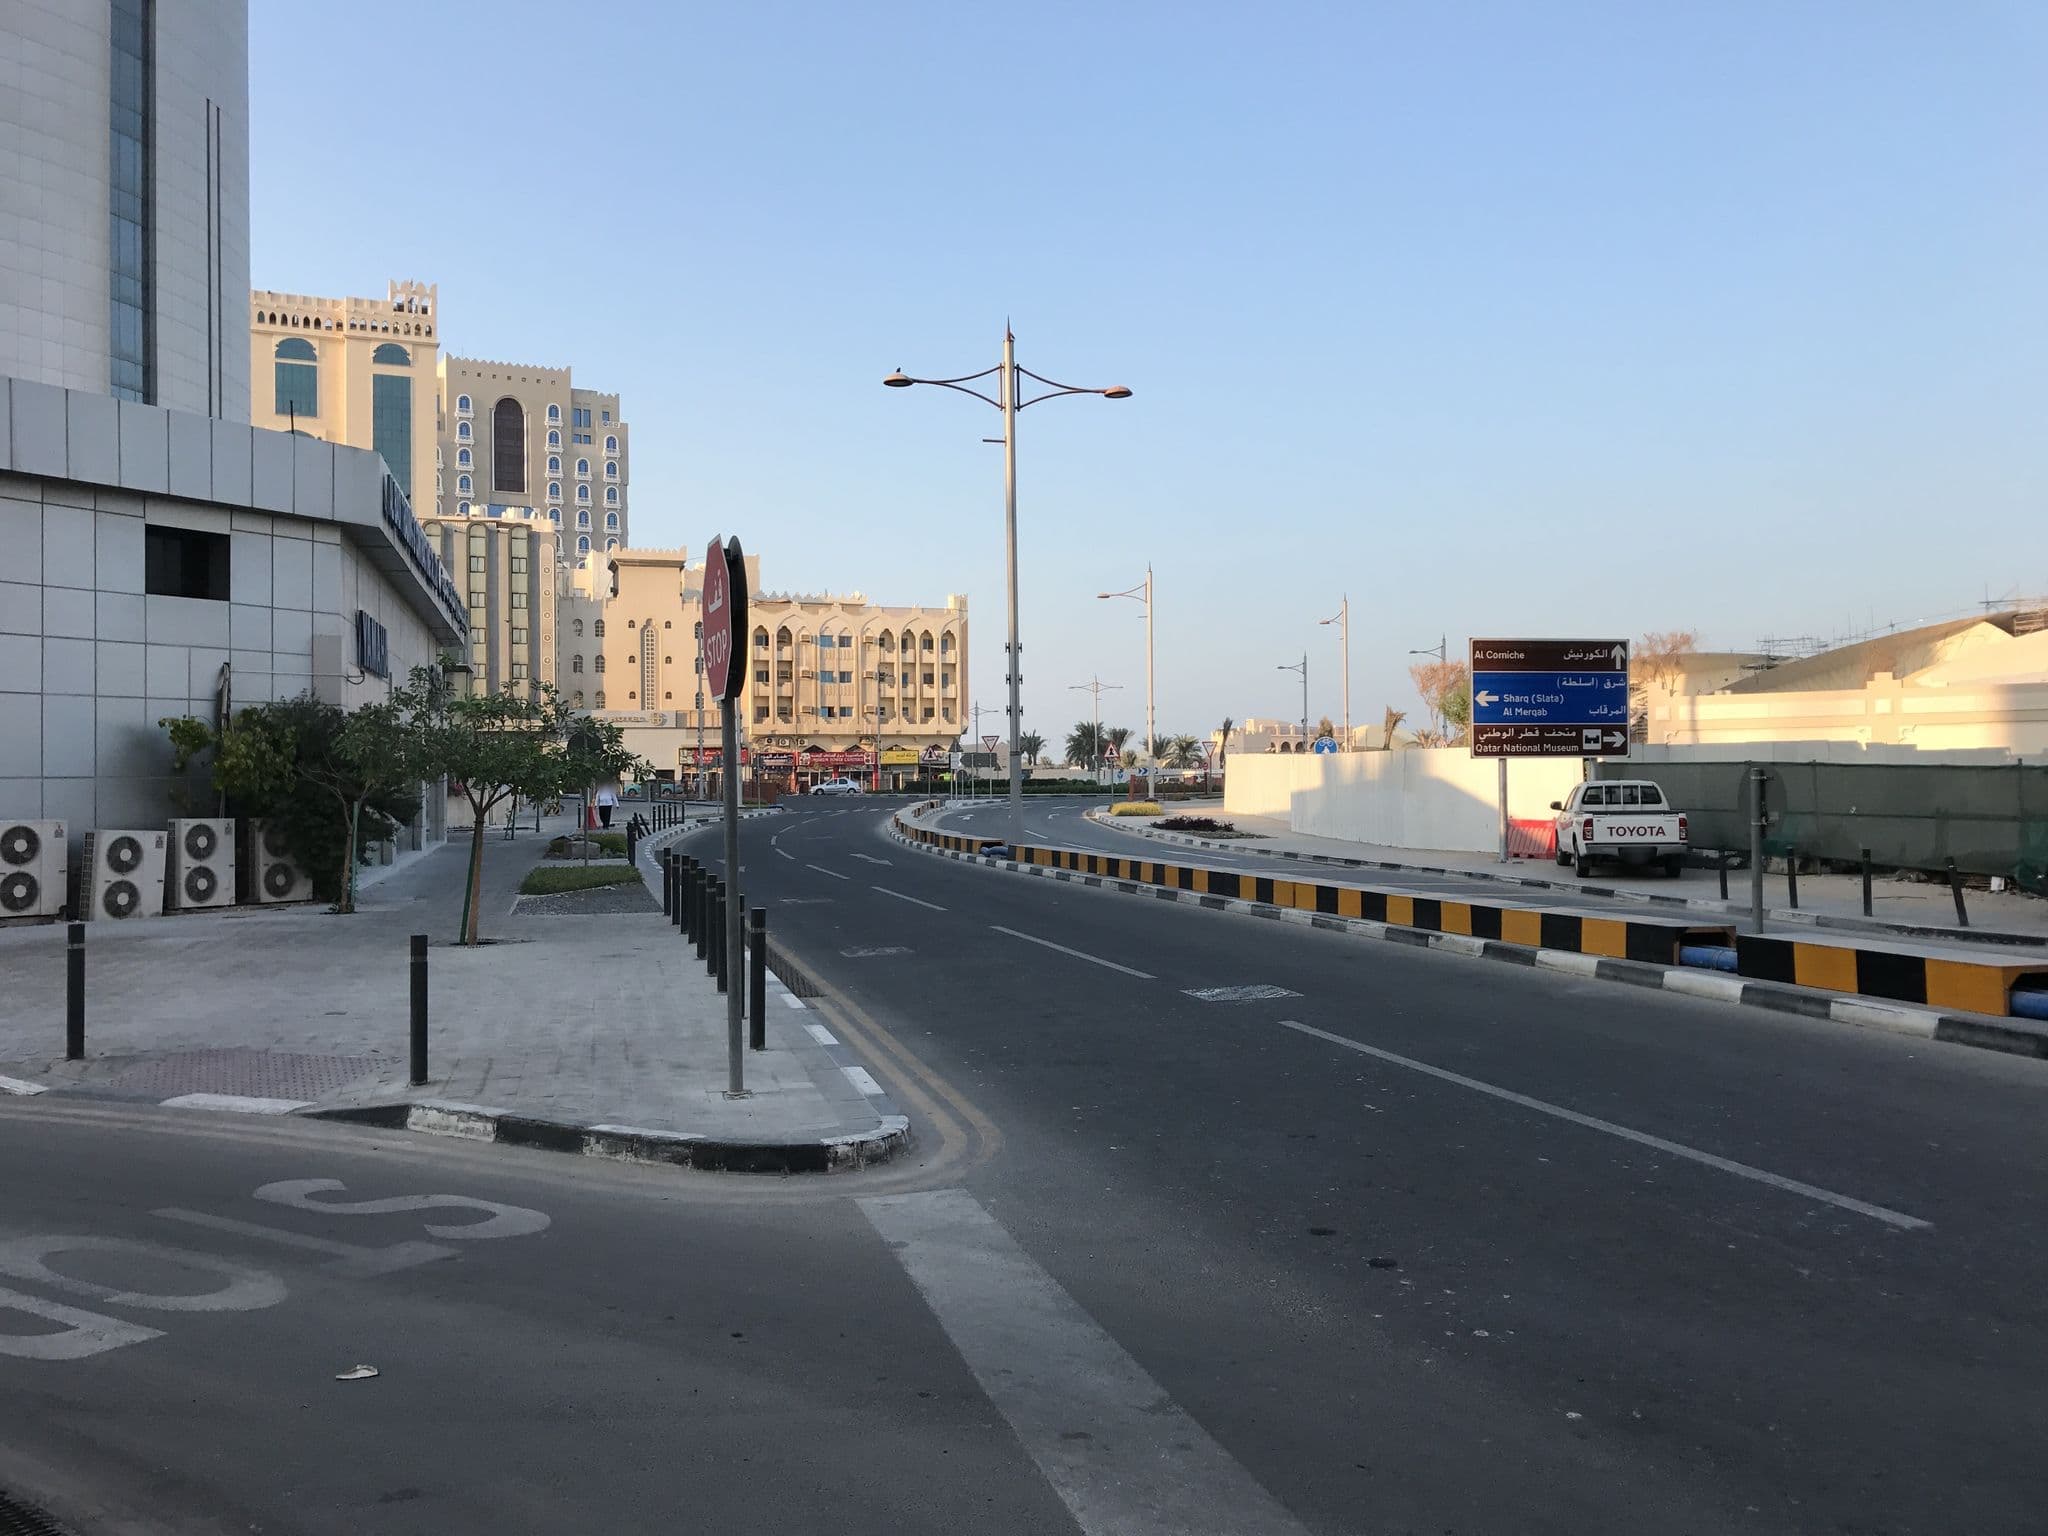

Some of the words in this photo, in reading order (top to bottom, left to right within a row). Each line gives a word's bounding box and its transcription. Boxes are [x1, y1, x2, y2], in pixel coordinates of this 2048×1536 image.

[706, 628, 728, 669] STOP
[1474, 650, 1484, 659] Al
[1486, 650, 1525, 660] Corniche
[1563, 649, 1608, 661] الكورنيش
[1603, 679, 1626, 689] شرق
[1503, 694, 1529, 703] Sharq
[1531, 693, 1564, 704] (Slata)
[1503, 707, 1513, 716] Al
[1514, 707, 1548, 717] Merqab
[1589, 704, 1626, 716] المرقاب
[1479, 727, 1514, 741] الوطني
[1518, 727, 1540, 739] قطر
[1544, 729, 1577, 738] متحف
[1475, 744, 1501, 753] Qatar
[1503, 744, 1541, 752] National
[1543, 744, 1579, 752] Museum
[1607, 825, 1666, 837] TOYOTA
